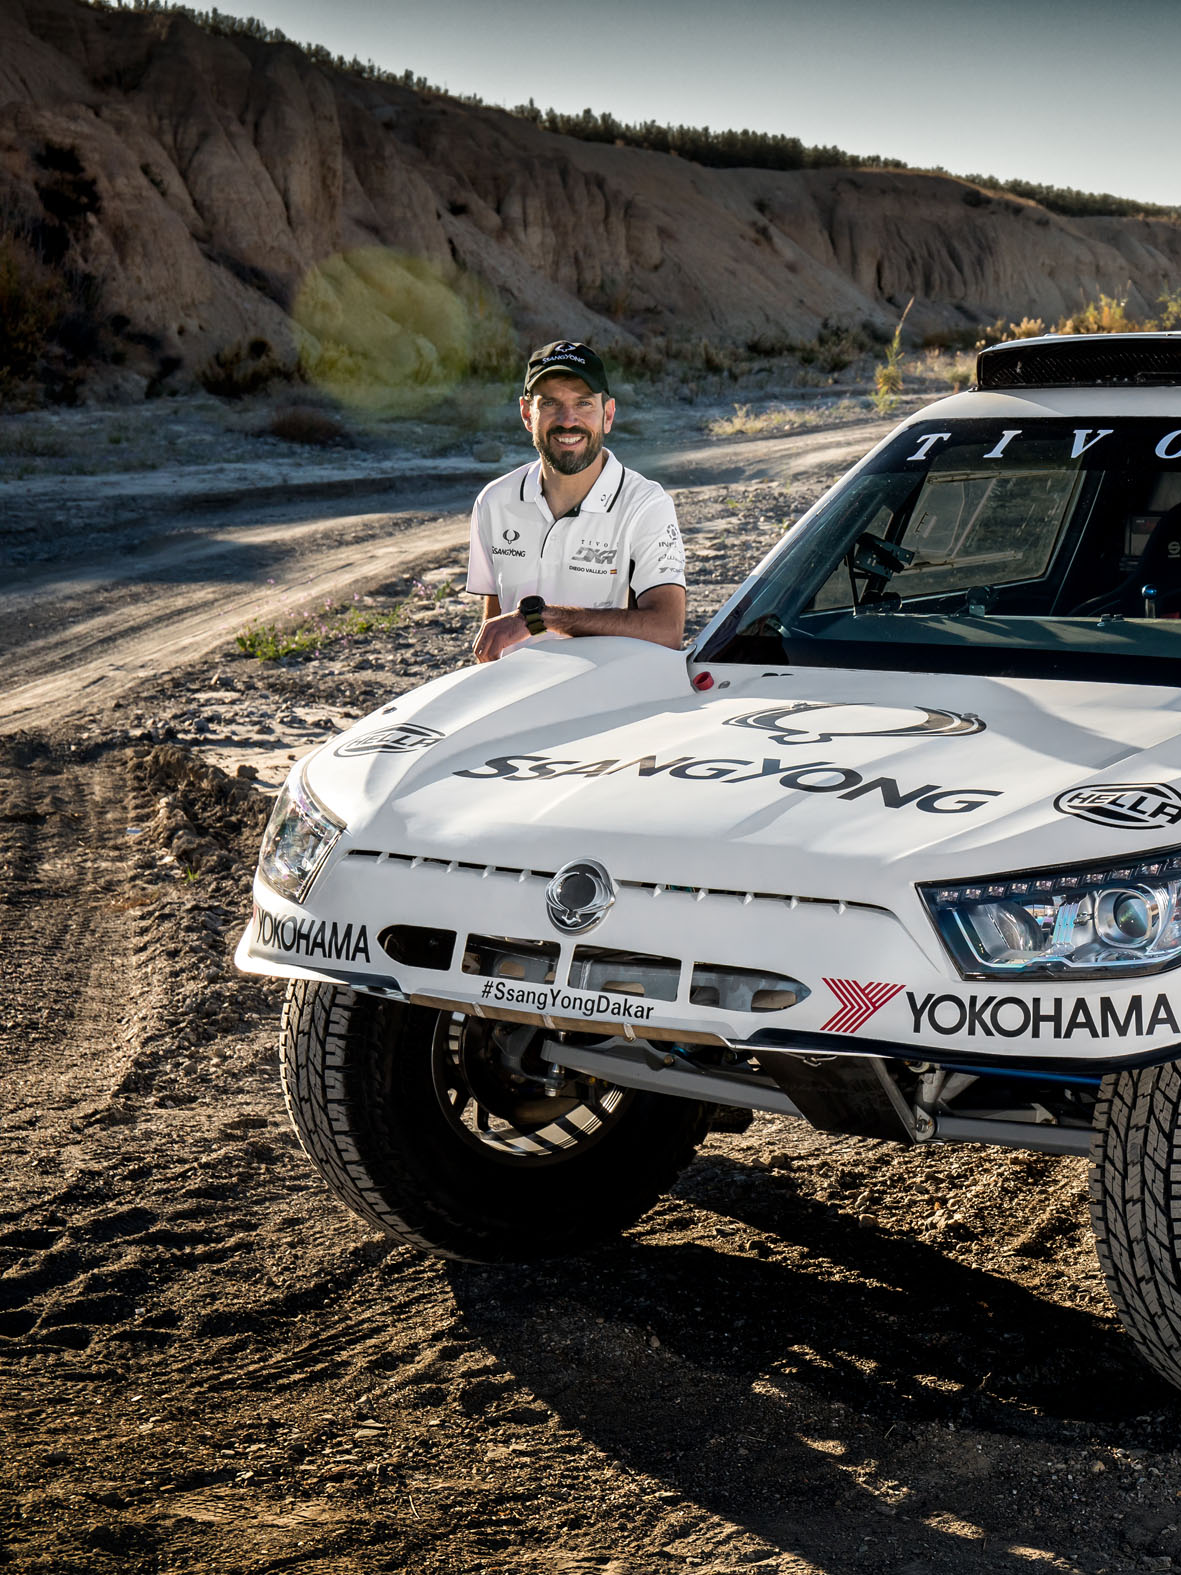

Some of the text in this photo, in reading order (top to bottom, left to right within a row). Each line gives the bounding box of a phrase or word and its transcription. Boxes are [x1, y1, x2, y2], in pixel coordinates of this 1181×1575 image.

[568, 565, 585, 573] DIEGO
[451, 754, 1005, 814] SSANGYONG
[256, 907, 371, 964] YOKOHAMA
[481, 979, 655, 1021] #SsangYongDakar
[905, 990, 1181, 1039] YOKOHAMA
